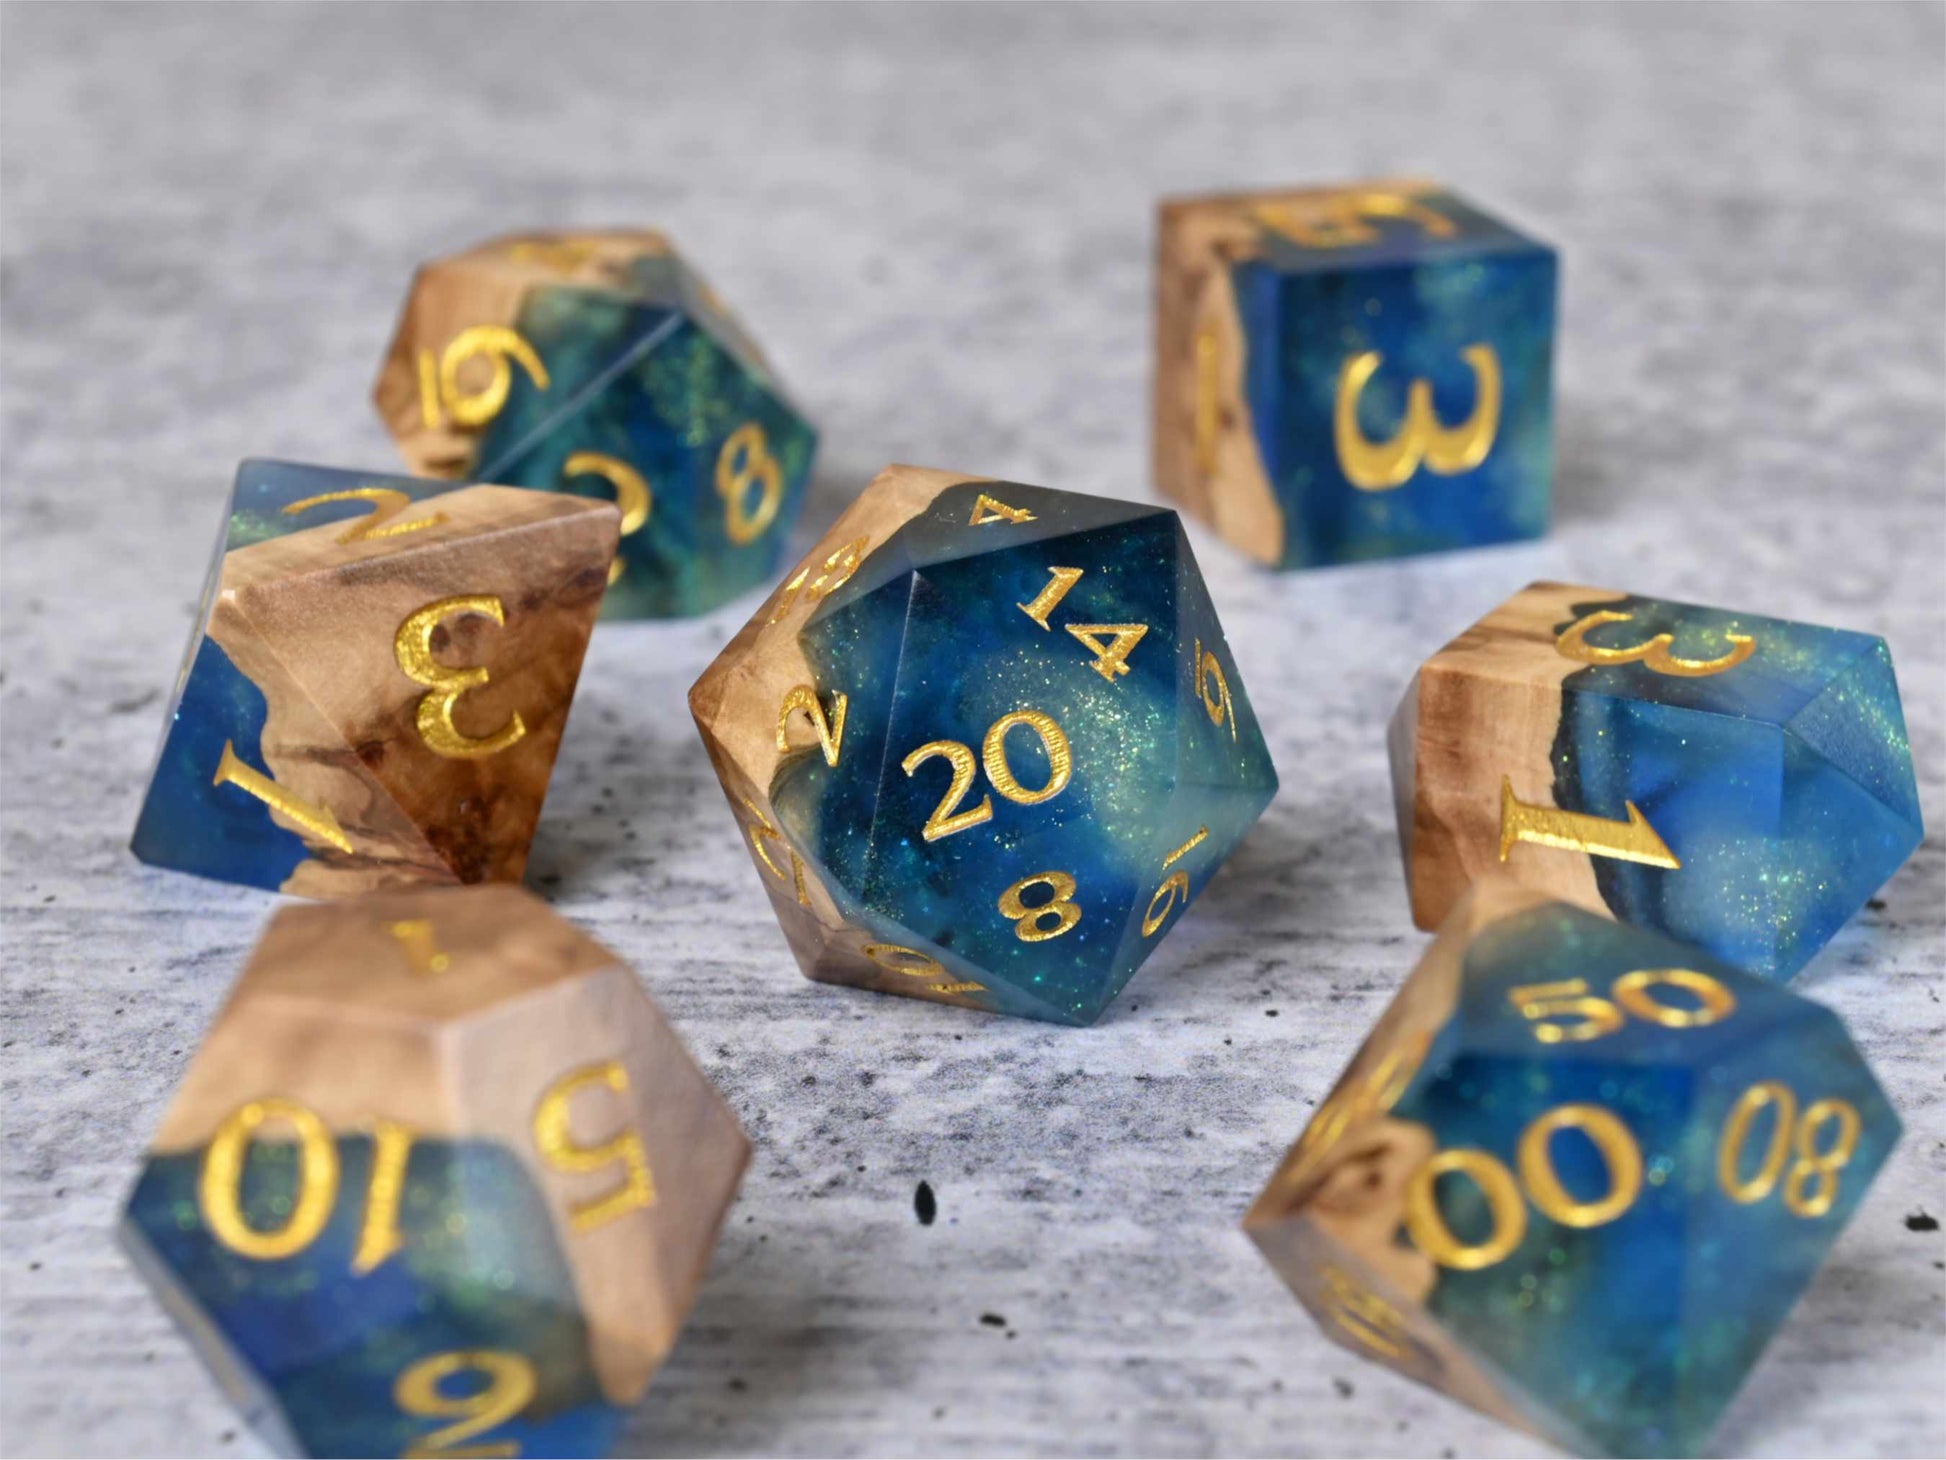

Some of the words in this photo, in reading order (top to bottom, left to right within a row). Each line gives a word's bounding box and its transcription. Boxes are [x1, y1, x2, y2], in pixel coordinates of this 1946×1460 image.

[1334, 343, 1502, 491] 3
[282, 489, 450, 545] 2
[716, 423, 782, 546] 8
[968, 494, 1037, 526] 4
[394, 594, 525, 759] 3
[1017, 566, 1148, 682] 14
[1556, 610, 1757, 677] 3
[777, 684, 848, 767] 2
[902, 709, 1072, 842] 20
[213, 739, 353, 854] 1
[1500, 774, 1681, 869] 1
[999, 870, 1082, 942] 8
[1508, 968, 1737, 1044] 50
[201, 1099, 413, 1276] 10
[535, 1061, 657, 1237] 5
[1403, 1104, 1643, 1270] 00
